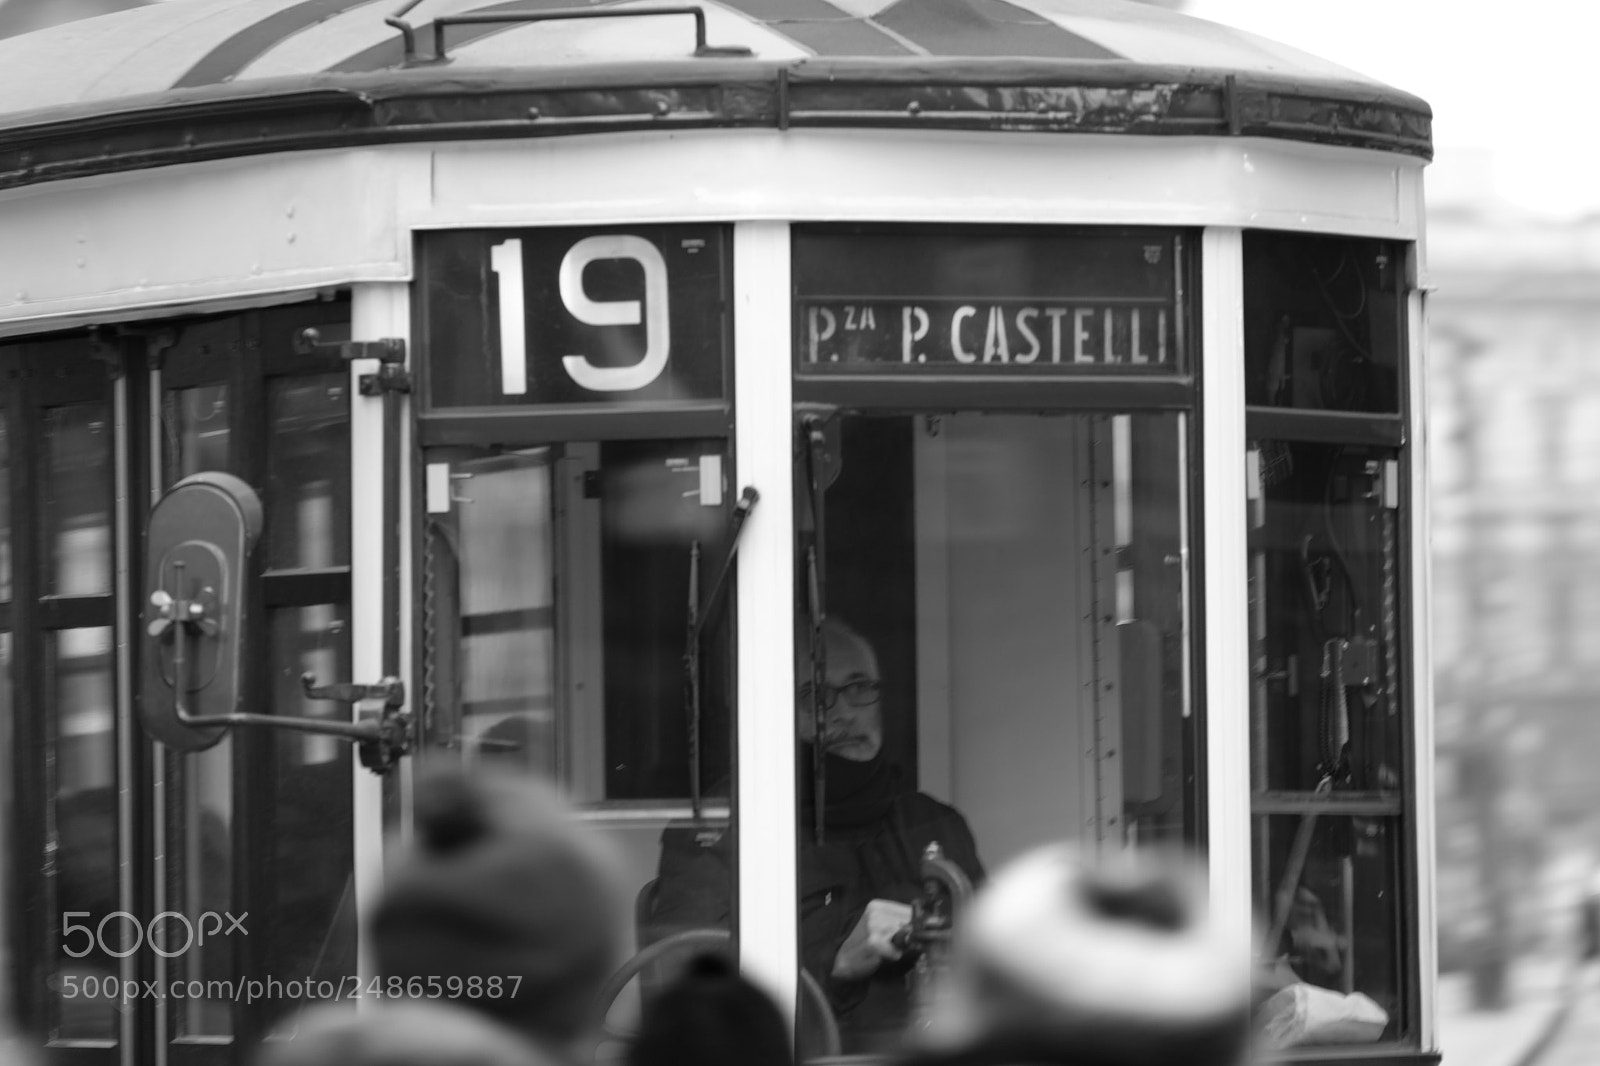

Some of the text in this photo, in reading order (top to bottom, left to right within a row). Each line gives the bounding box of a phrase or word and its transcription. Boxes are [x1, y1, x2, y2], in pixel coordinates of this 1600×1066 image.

[490, 234, 670, 395] 19
[902, 306, 930, 364] P.
[950, 305, 1167, 364] CASTELLI
